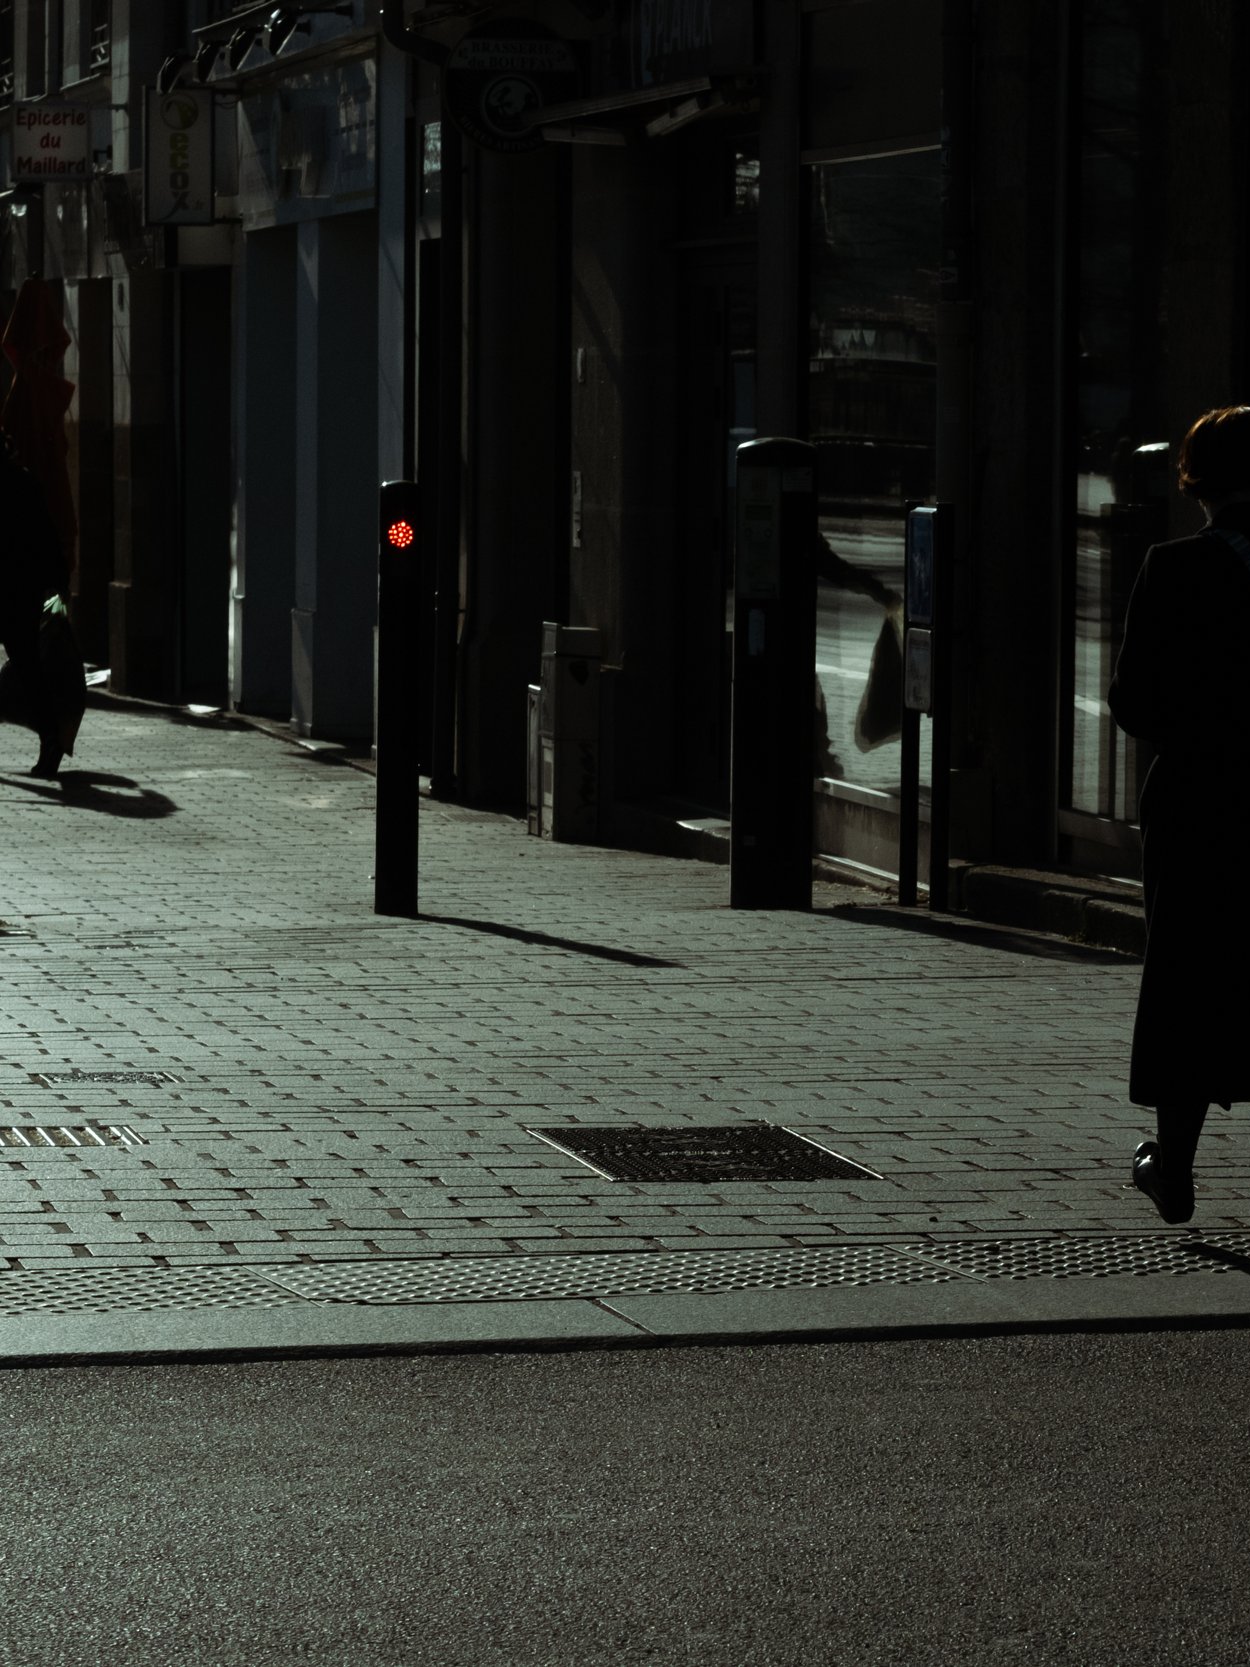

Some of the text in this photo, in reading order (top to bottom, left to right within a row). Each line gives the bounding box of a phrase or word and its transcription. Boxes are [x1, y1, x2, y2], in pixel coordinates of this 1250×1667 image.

[471, 41, 554, 54] BRASSERIE
[16, 108, 86, 130] Epicerie
[40, 133, 61, 148] du
[17, 157, 85, 174] Maillard
